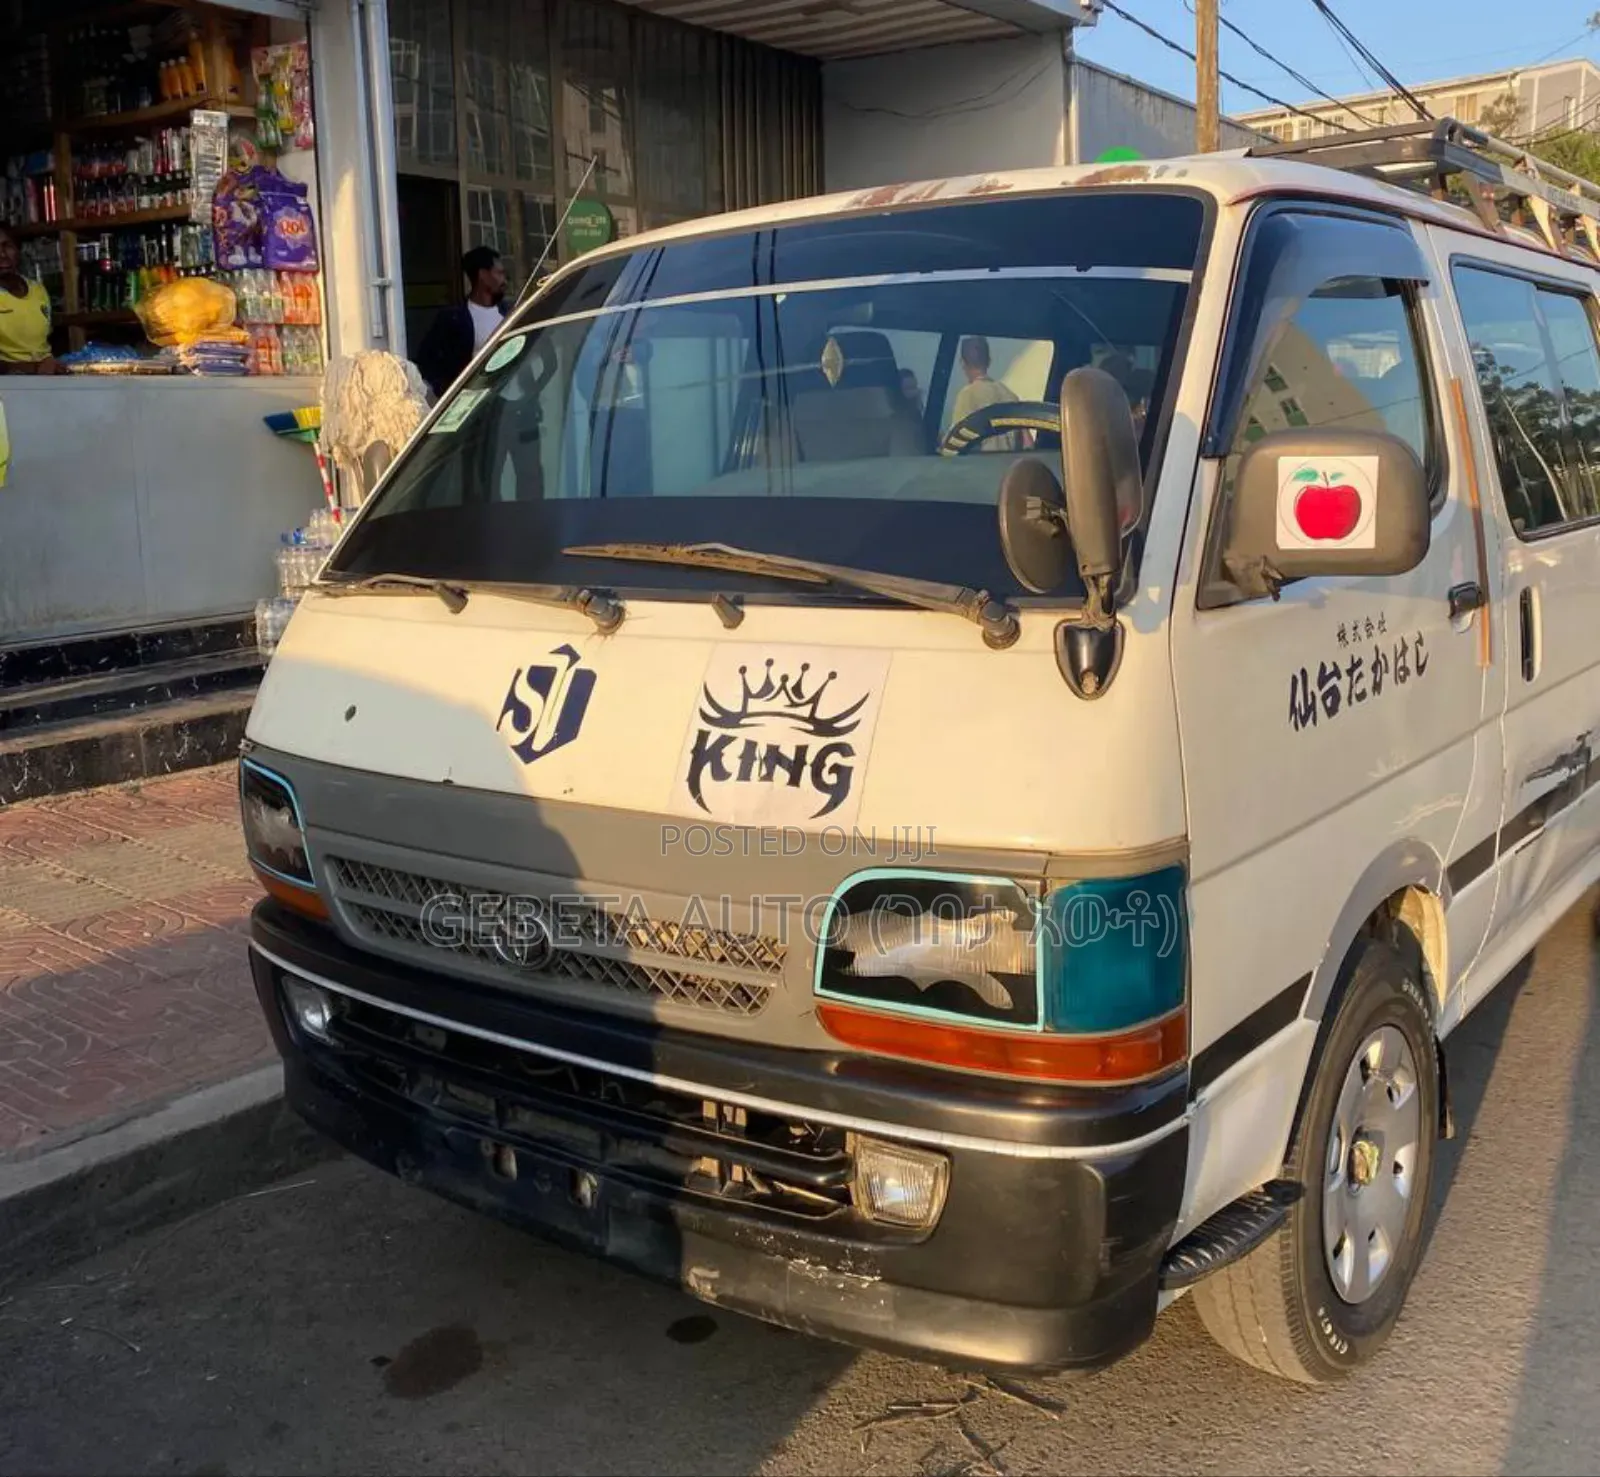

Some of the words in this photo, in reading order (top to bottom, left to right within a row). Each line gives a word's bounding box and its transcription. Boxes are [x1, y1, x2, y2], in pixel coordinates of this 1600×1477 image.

[1336, 611, 1388, 648] 株式会社
[1288, 630, 1429, 732] 仙台たかはし
[686, 729, 857, 819] KING
